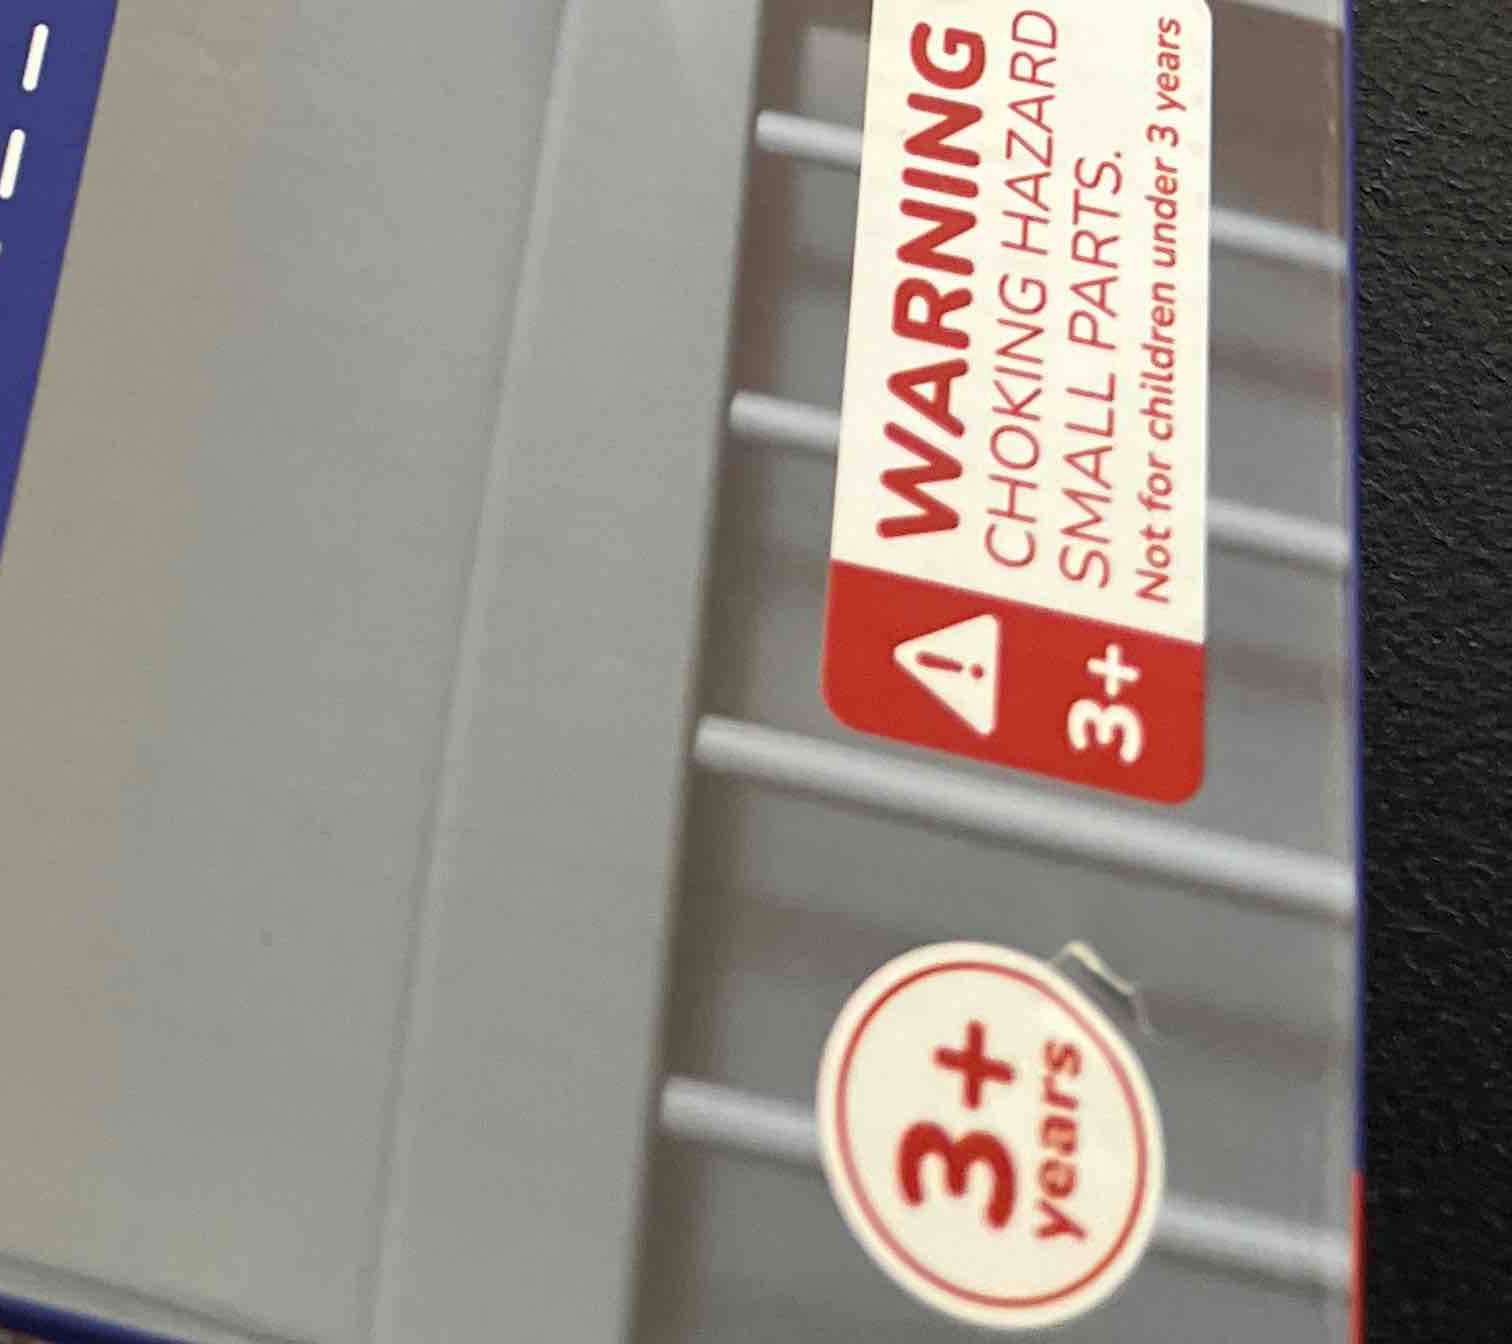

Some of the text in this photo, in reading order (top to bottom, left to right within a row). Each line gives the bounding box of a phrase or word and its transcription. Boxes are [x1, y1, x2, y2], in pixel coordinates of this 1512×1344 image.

[876, 21, 987, 540] WARNING
[984, 9, 1059, 569] CHOKING HAZARD
[1059, 150, 1123, 588] SMALL PARTS.
[1138, 18, 1187, 603] Not for children under 3 years
[1068, 644, 1143, 763] 3+
[895, 1020, 1018, 1232] 3+
[1036, 1040, 1087, 1241] years
